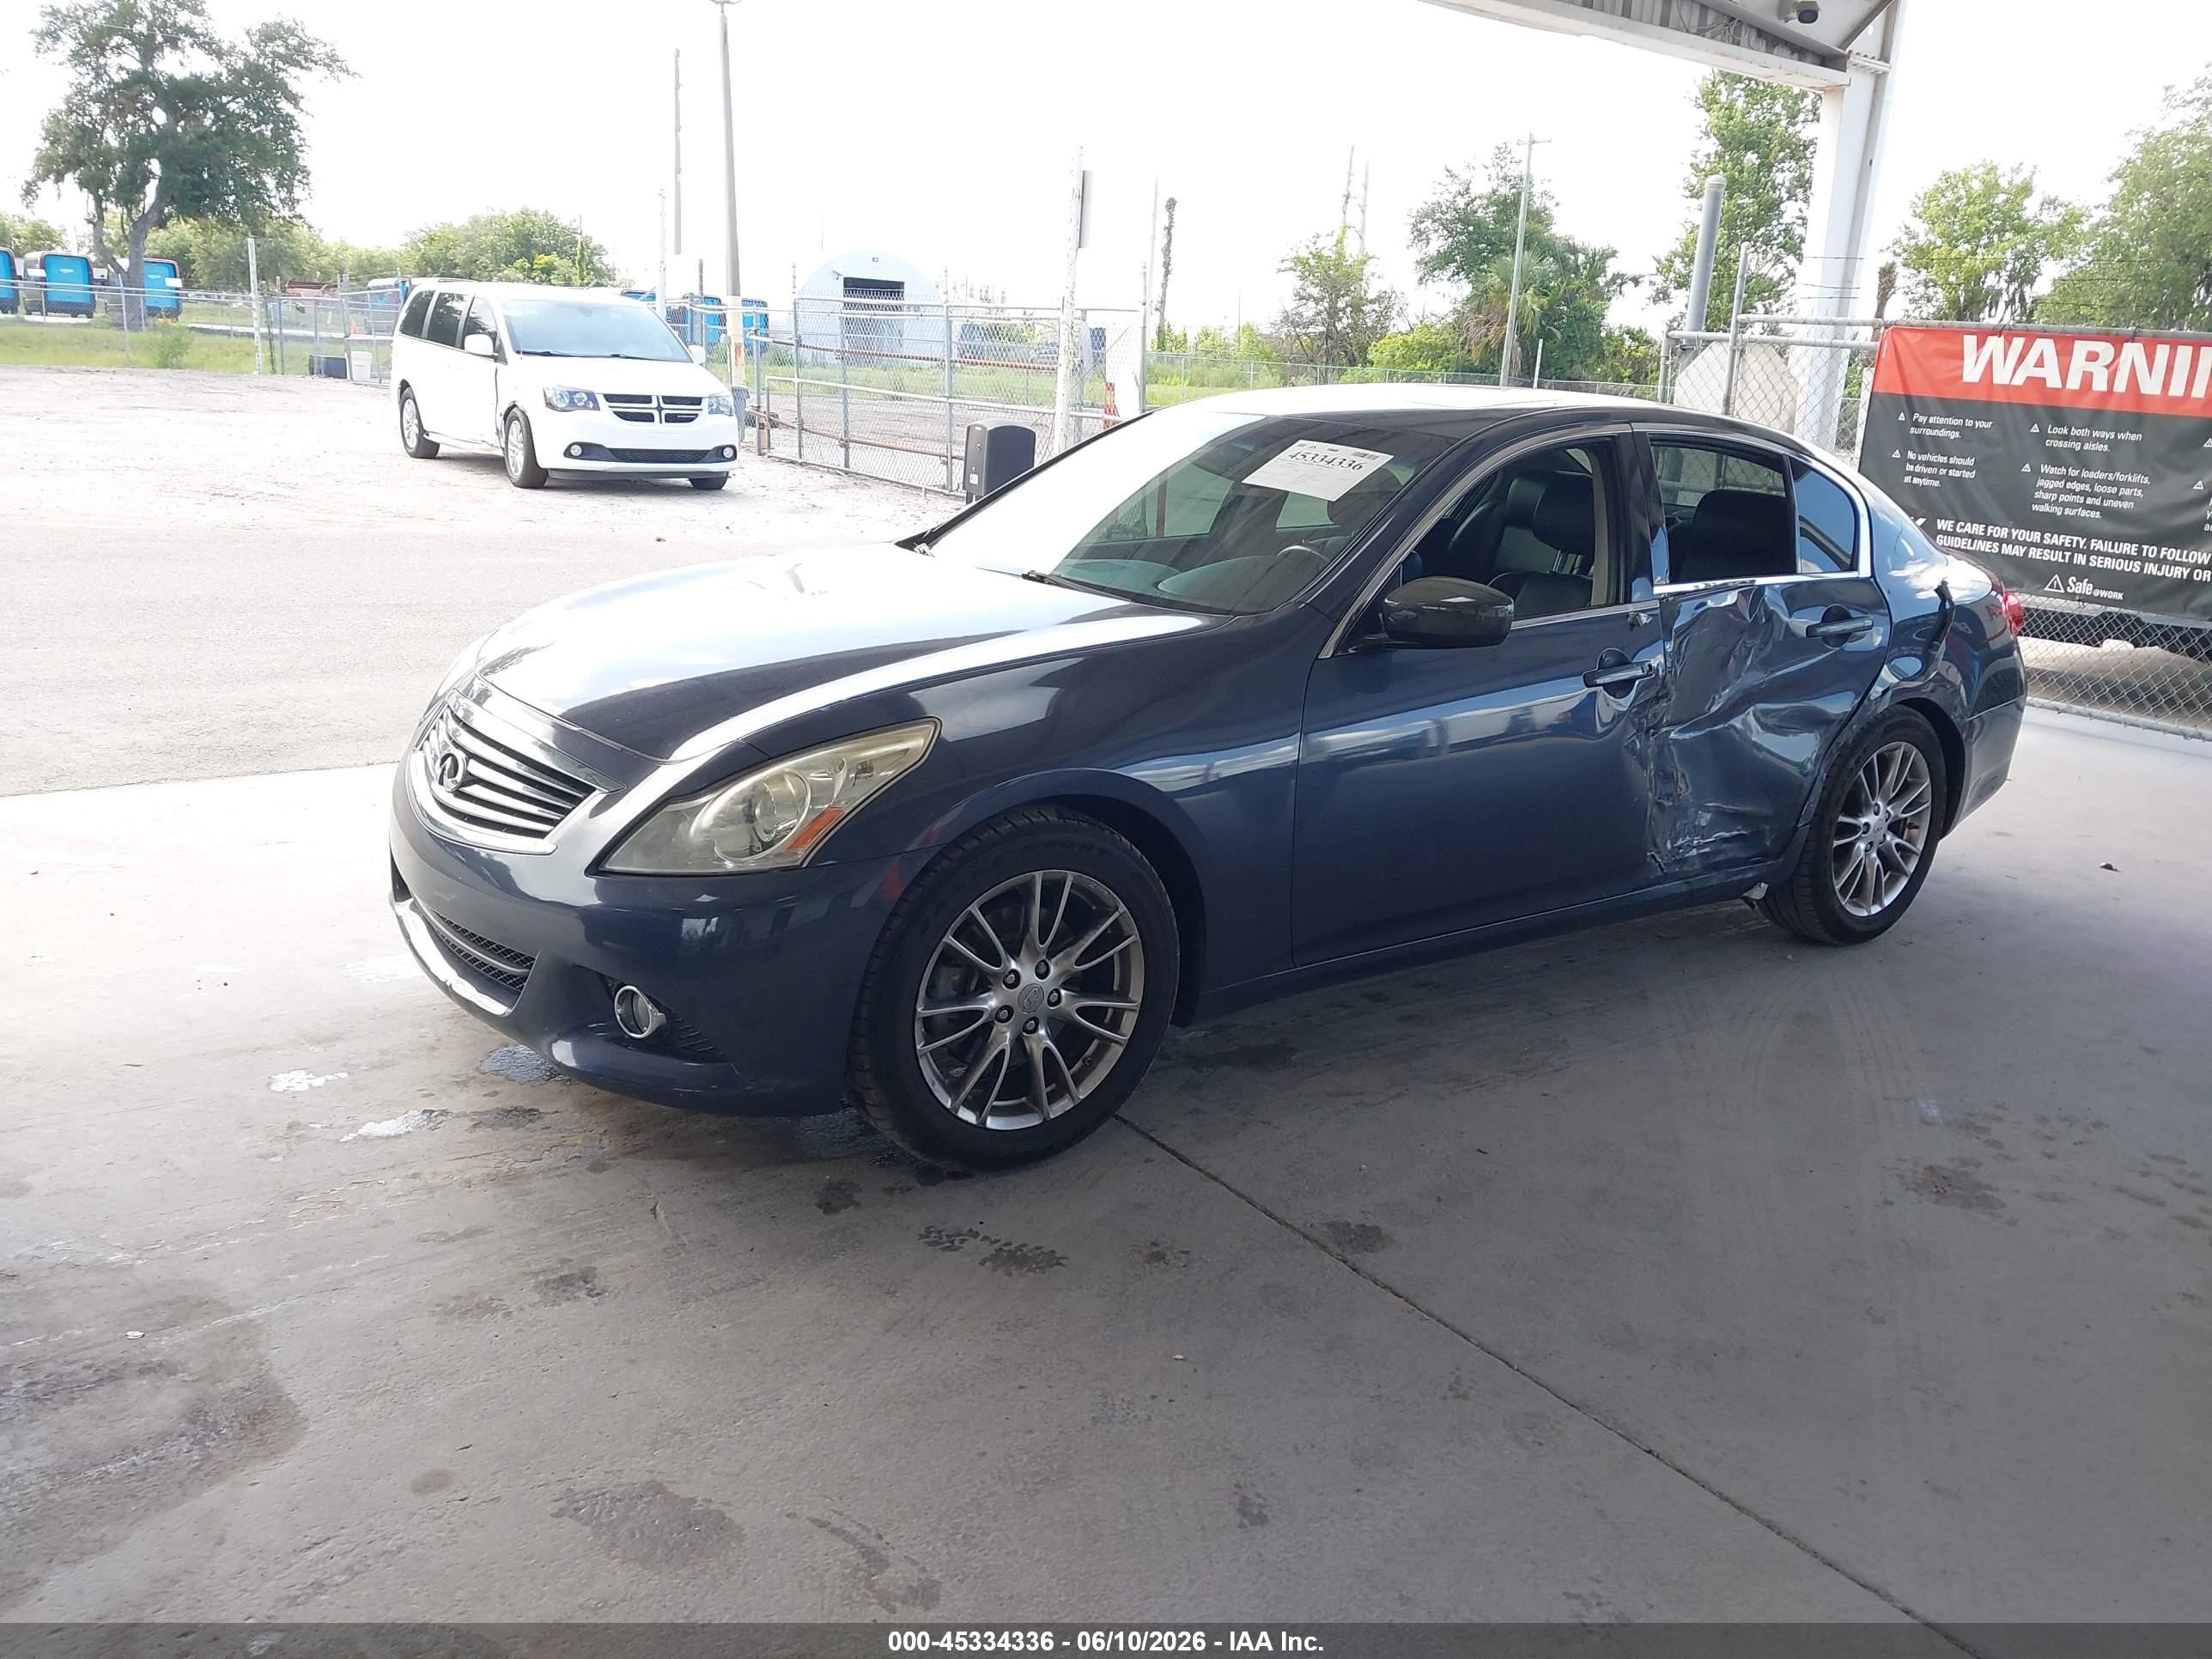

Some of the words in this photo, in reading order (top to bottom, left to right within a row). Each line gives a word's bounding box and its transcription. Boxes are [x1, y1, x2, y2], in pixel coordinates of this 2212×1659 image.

[1913, 413, 1928, 424] Pay
[1929, 415, 1963, 426] attention
[1965, 418, 1973, 427] to
[1974, 420, 1992, 428] your
[1910, 426, 1961, 439] surroundings.
[2047, 424, 2069, 434] Look
[2070, 426, 2090, 437] both
[2092, 429, 2115, 440] ways
[2117, 430, 2142, 441] when
[2045, 439, 2081, 451] crossing
[2082, 441, 2111, 452] aisles.
[1288, 451, 1364, 471] 45334336
[1907, 449, 1917, 460] No
[1917, 453, 1948, 464] vehicles
[1949, 455, 1975, 466] should
[1905, 462, 1914, 472] be
[1915, 464, 1937, 475] driven
[1948, 469, 1976, 478] started
[2040, 464, 2066, 476] Watch
[2068, 466, 2080, 477] for
[2081, 468, 2151, 485] loaders/forklifts,
[1904, 475, 1911, 483] at
[1912, 476, 1941, 487] anytime.
[2036, 477, 2065, 489] jagged
[2066, 480, 2091, 492] edges,
[2094, 483, 2118, 494] loose
[2118, 487, 2144, 498] parts,
[2034, 489, 2057, 501] sharp
[2058, 493, 2085, 504] points
[2086, 495, 2101, 506] and
[2103, 499, 2134, 509] uneven
[2032, 503, 2063, 516] walking
[2063, 507, 2103, 519] surfaces.
[1936, 519, 1955, 532] WE
[1956, 521, 1985, 536] CARE
[1986, 526, 2008, 539] FOR
[2010, 528, 2042, 542] YOUR
[2044, 532, 2087, 550] SAFETY.
[2089, 538, 2139, 556] FAILURE
[2141, 544, 2158, 558] TO
[2160, 547, 2212, 565] FOLLOW
[1936, 534, 2000, 553] GUIDELINES
[2001, 544, 2027, 557] MAY
[2027, 548, 2072, 563] RESULT
[2073, 552, 2087, 565] IN
[2088, 555, 2142, 573] SERIOUS
[2143, 562, 2191, 580] INJURY
[2193, 568, 2212, 582] OR
